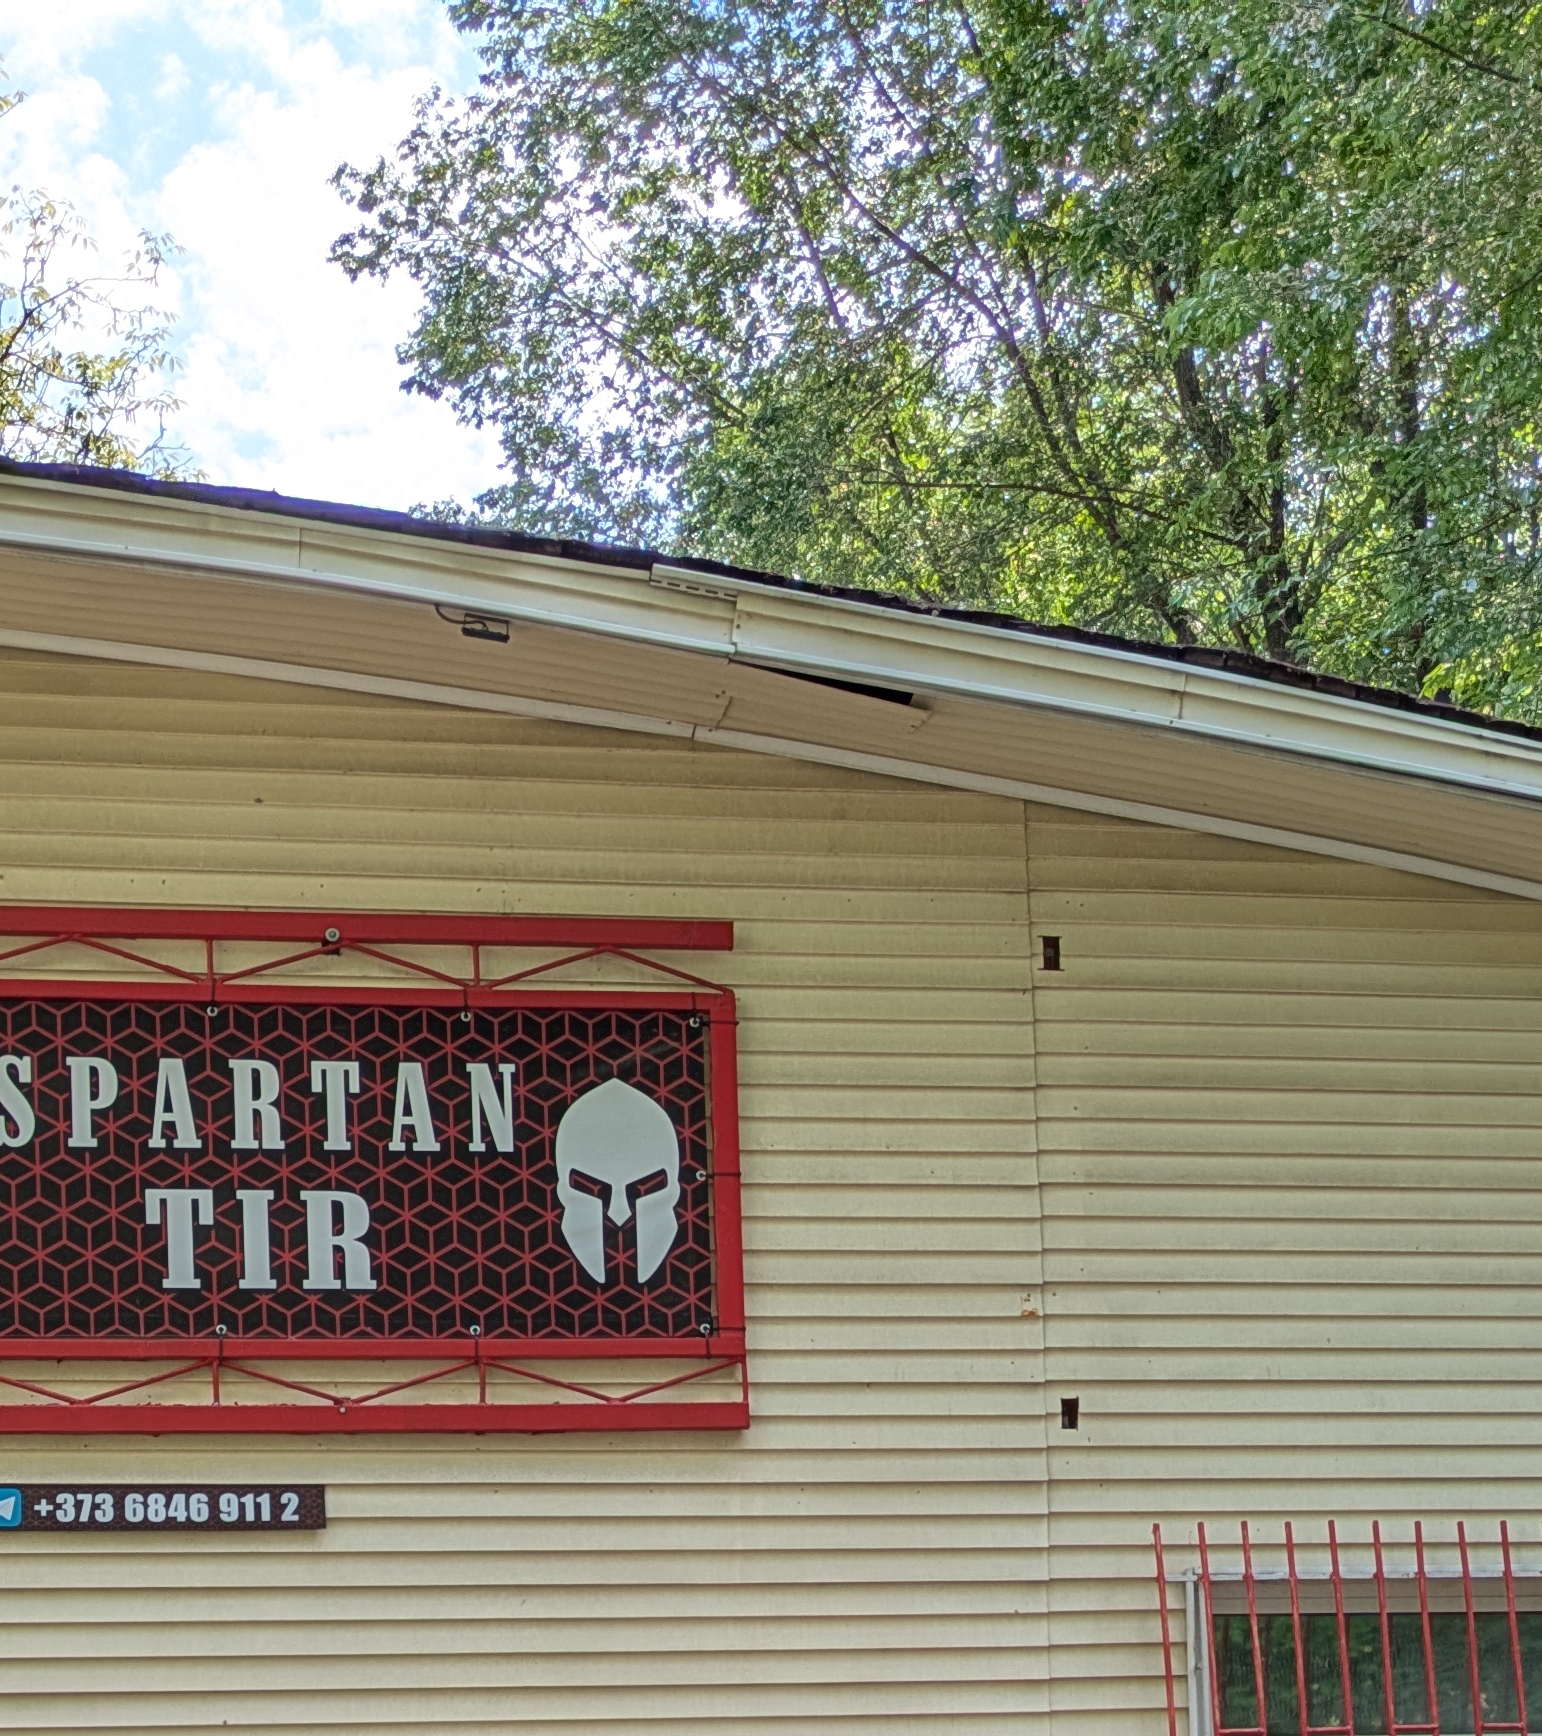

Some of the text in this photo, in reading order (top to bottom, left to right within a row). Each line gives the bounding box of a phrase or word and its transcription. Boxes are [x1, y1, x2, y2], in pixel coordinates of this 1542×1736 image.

[144, 1188, 378, 1292] TIR
[33, 1492, 115, 1523] +373
[124, 1492, 209, 1523] 6846
